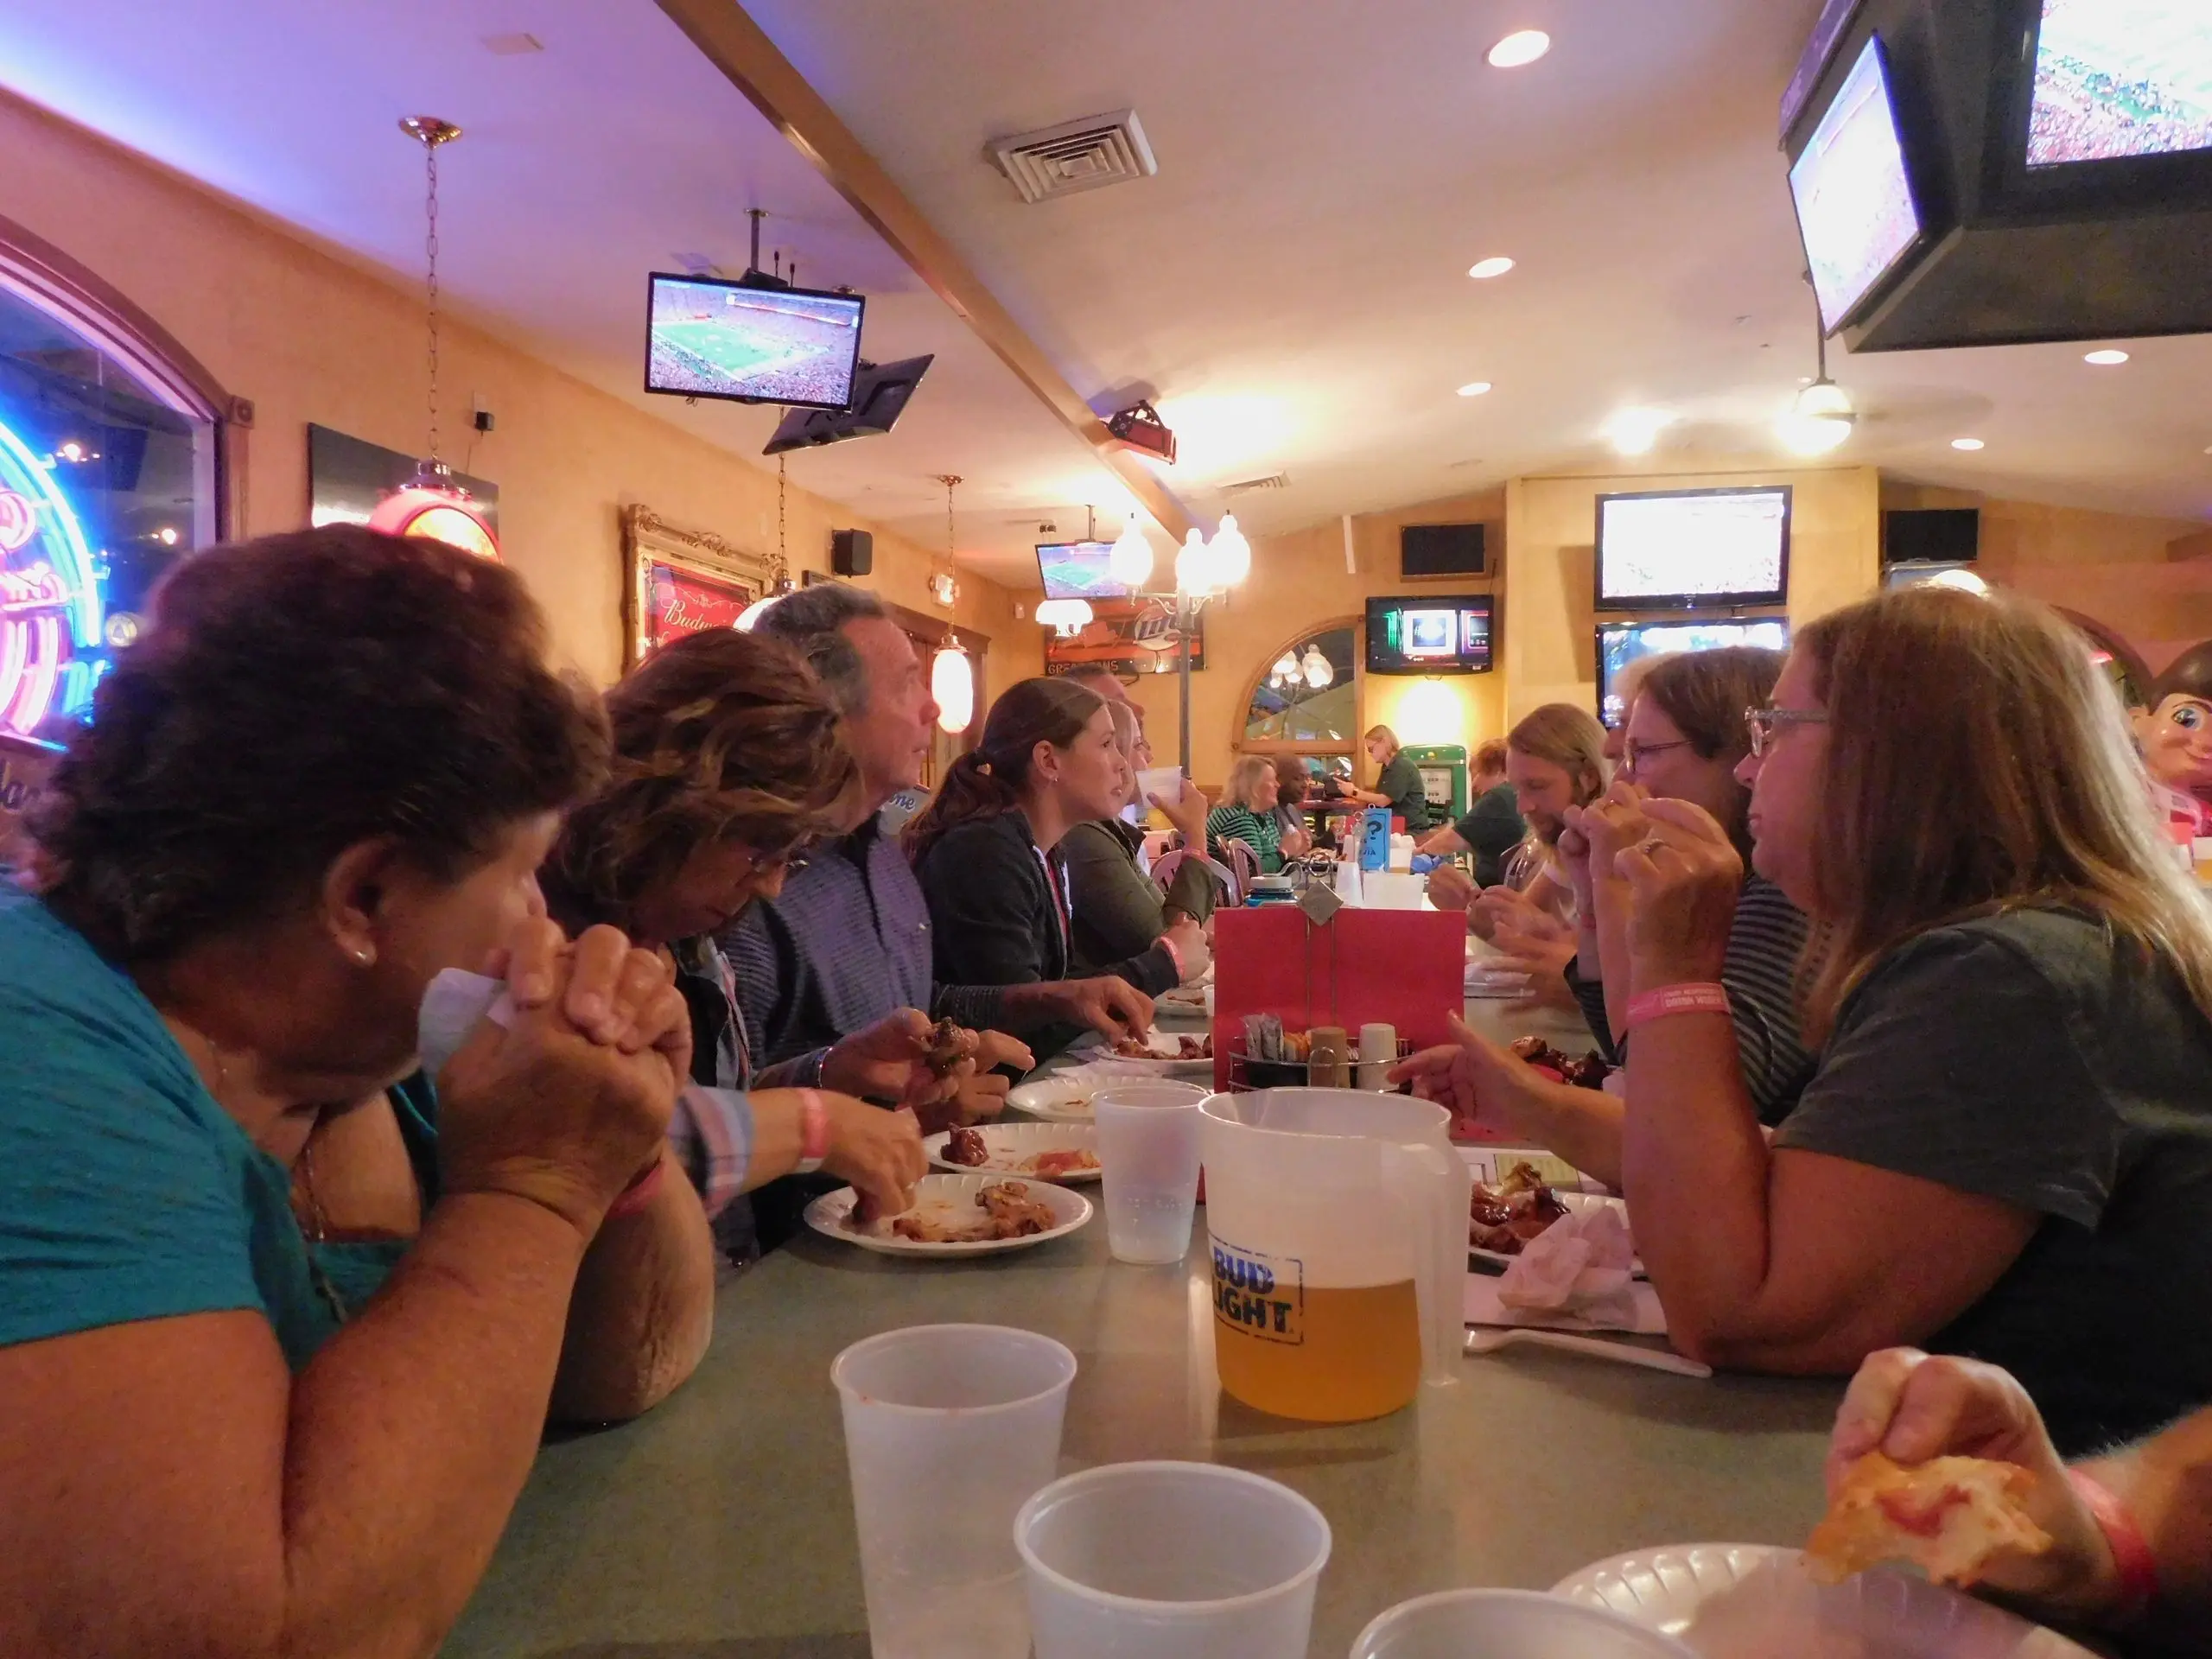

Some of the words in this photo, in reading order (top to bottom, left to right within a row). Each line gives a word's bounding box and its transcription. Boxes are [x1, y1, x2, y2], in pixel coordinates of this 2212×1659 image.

[660, 598, 719, 631] Budw
[1213, 1246, 1275, 1294] BUD
[1213, 1281, 1293, 1333] IGHT
